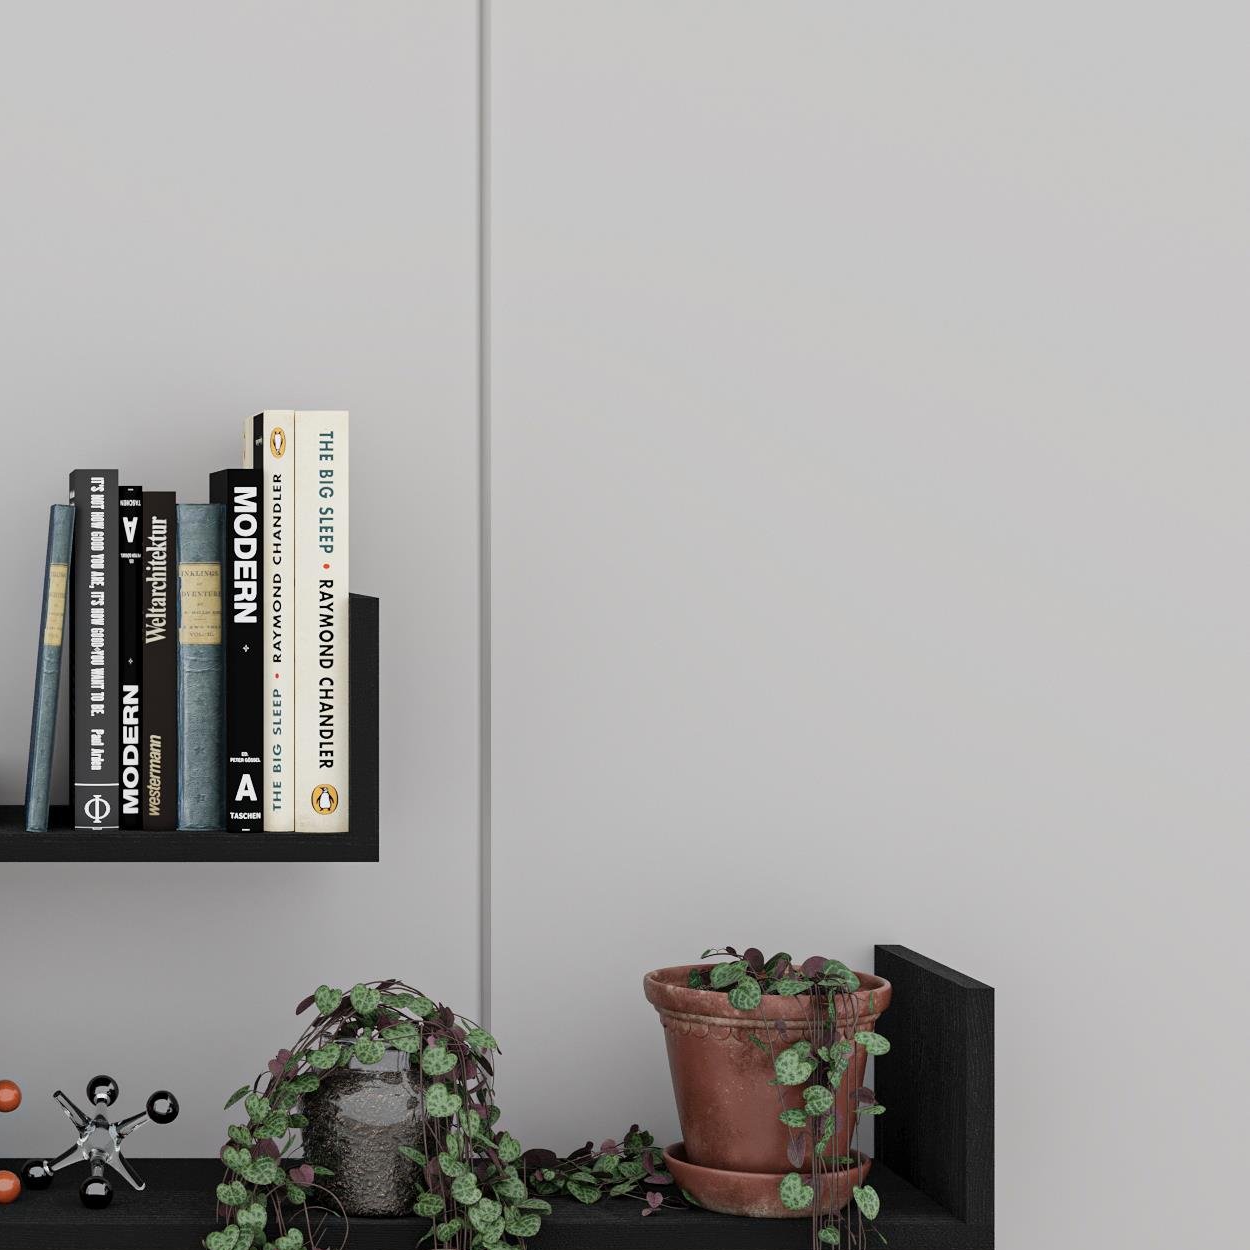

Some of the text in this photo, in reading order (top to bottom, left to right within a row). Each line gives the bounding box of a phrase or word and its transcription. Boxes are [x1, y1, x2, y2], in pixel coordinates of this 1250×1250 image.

[90, 494, 104, 509] NOT
[90, 512, 104, 529] HOW
[122, 517, 138, 543] A
[90, 531, 104, 551] GOOD
[233, 486, 258, 623] MODERN
[90, 553, 104, 569] YOU
[145, 516, 167, 644] Weltarchitektur
[319, 431, 334, 768] THE BIG SLEEP RAYMOND CHANDLER
[272, 474, 282, 811] THE BIG SLEEP RAYMOND CHANDLER
[90, 668, 104, 689] WANT
[90, 691, 104, 702] TO
[90, 729, 104, 770] Paul Arden
[122, 684, 139, 815] MODERN
[147, 734, 162, 816] westermann
[234, 773, 258, 801] A
[230, 812, 261, 820] TASCHEN
